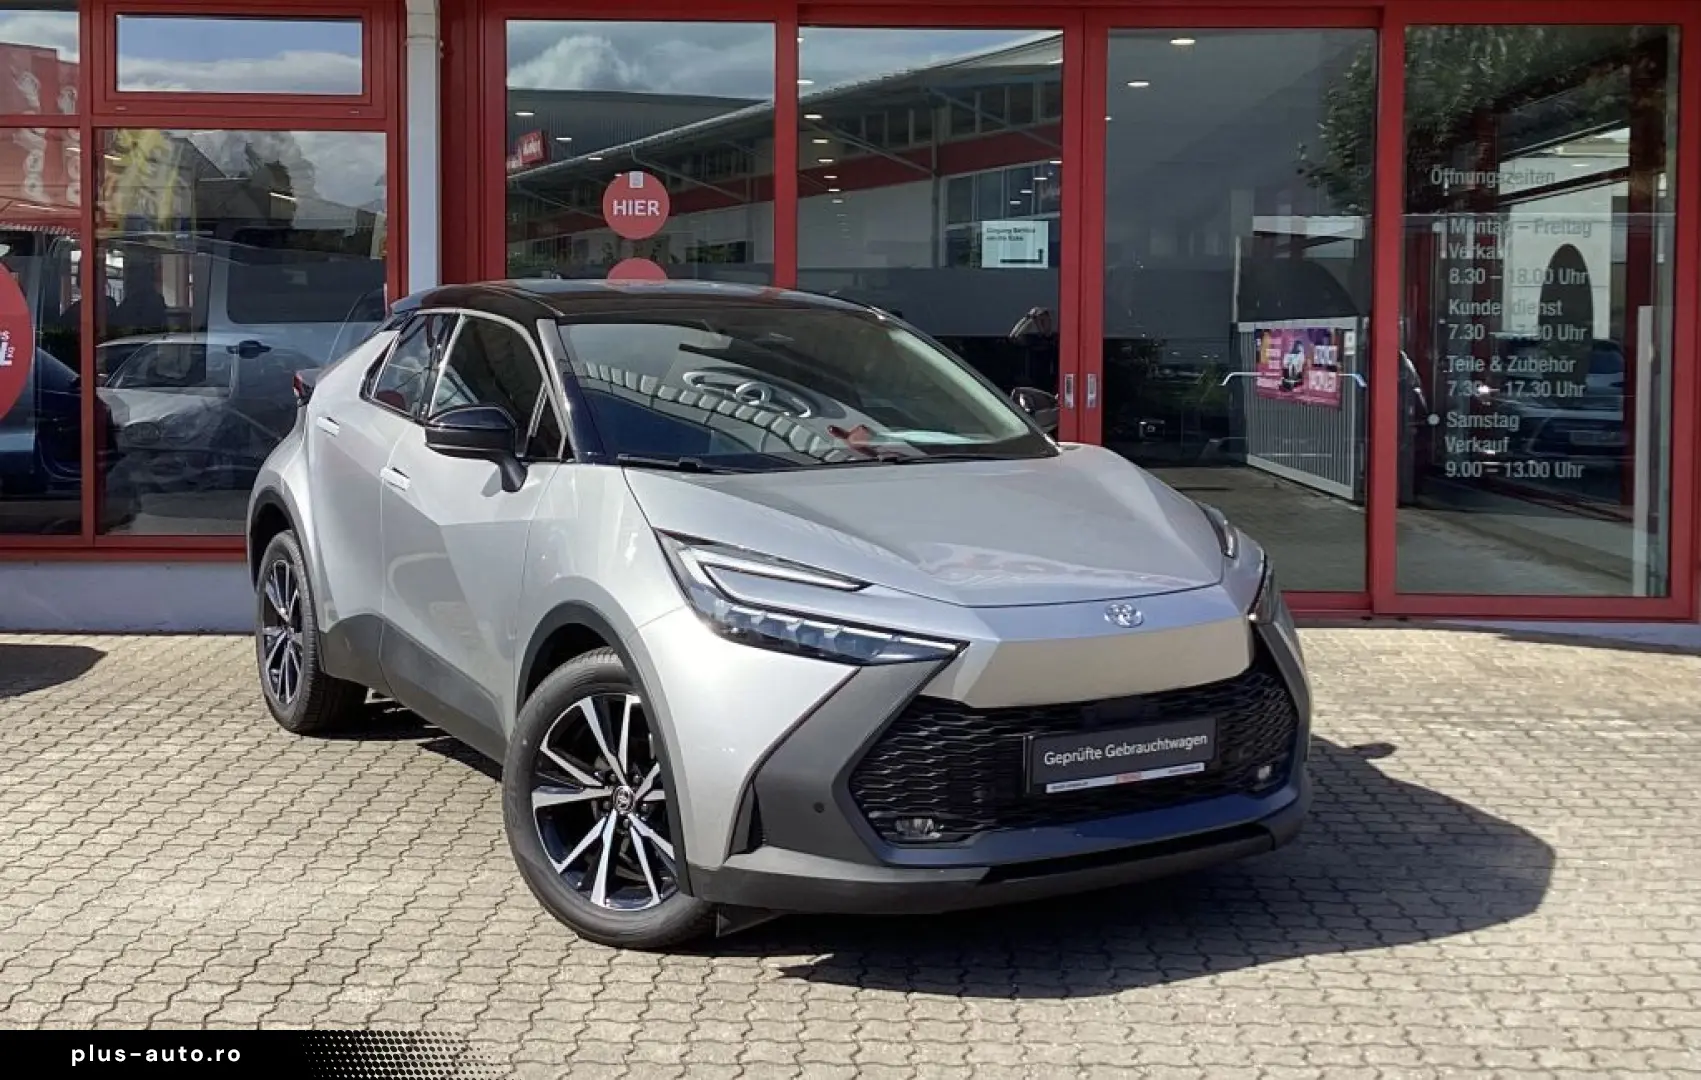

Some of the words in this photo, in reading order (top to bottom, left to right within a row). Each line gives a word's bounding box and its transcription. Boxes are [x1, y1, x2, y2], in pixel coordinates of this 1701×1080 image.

[1431, 164, 1555, 188] Öffnungszeiten
[613, 199, 660, 216] HIER
[1534, 217, 1592, 238] Freitag
[1450, 267, 1486, 284] 8.30
[1558, 267, 1588, 284] Uhr
[1449, 299, 1563, 316] Kundedienst
[1448, 323, 1486, 340] 7.30
[1557, 323, 1587, 340] Uhr
[1447, 355, 1486, 373] Teile
[1490, 355, 1503, 373] &
[1507, 354, 1577, 373] Zubehör
[1506, 380, 1551, 397] 17.30
[1556, 379, 1586, 397] Uhr
[1446, 411, 1521, 431] Samstag
[1444, 436, 1511, 453] Verkauf
[1445, 461, 1483, 478] 9.00
[1504, 460, 1550, 477] 13.00
[1554, 461, 1585, 477] Uhr
[1043, 747, 1102, 766] Geprüfte
[1105, 734, 1208, 757] Gebrauchtwagen
